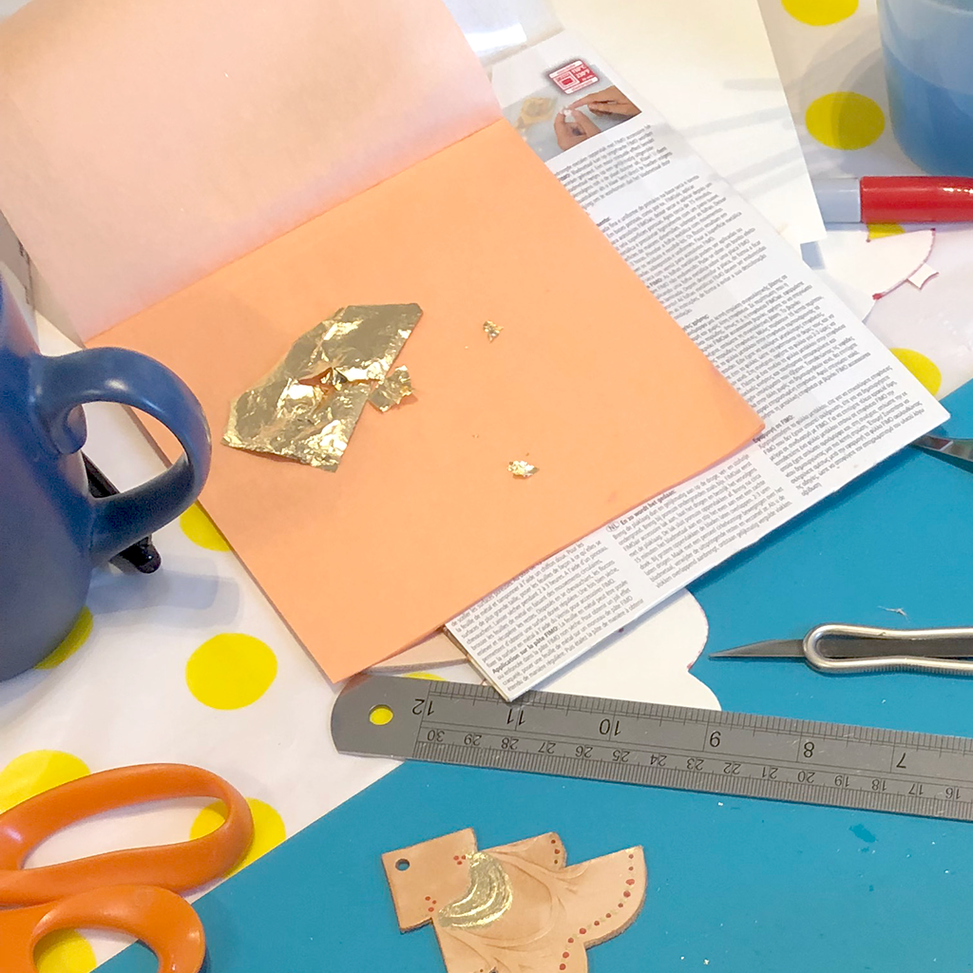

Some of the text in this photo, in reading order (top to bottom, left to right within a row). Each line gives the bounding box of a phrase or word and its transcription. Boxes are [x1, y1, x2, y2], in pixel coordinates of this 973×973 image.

[492, 654, 519, 673] Application
[412, 698, 434, 716] 12
[507, 708, 526, 725] 11
[600, 718, 621, 736] 10
[427, 729, 445, 742] 30
[464, 734, 482, 746] 29
[710, 730, 721, 748] 9
[501, 737, 519, 750] 28
[538, 742, 556, 754] 27
[804, 742, 814, 758] 8
[575, 746, 594, 758] 26
[612, 750, 630, 762] 25
[650, 754, 668, 767] 24
[686, 758, 704, 770] 23
[896, 752, 906, 768] 7
[724, 762, 741, 774] 22
[762, 766, 778, 780] 21
[798, 770, 816, 784] 20
[834, 775, 850, 788] 19
[872, 778, 886, 792] 18
[908, 784, 924, 796] 17
[946, 788, 960, 800] 16
